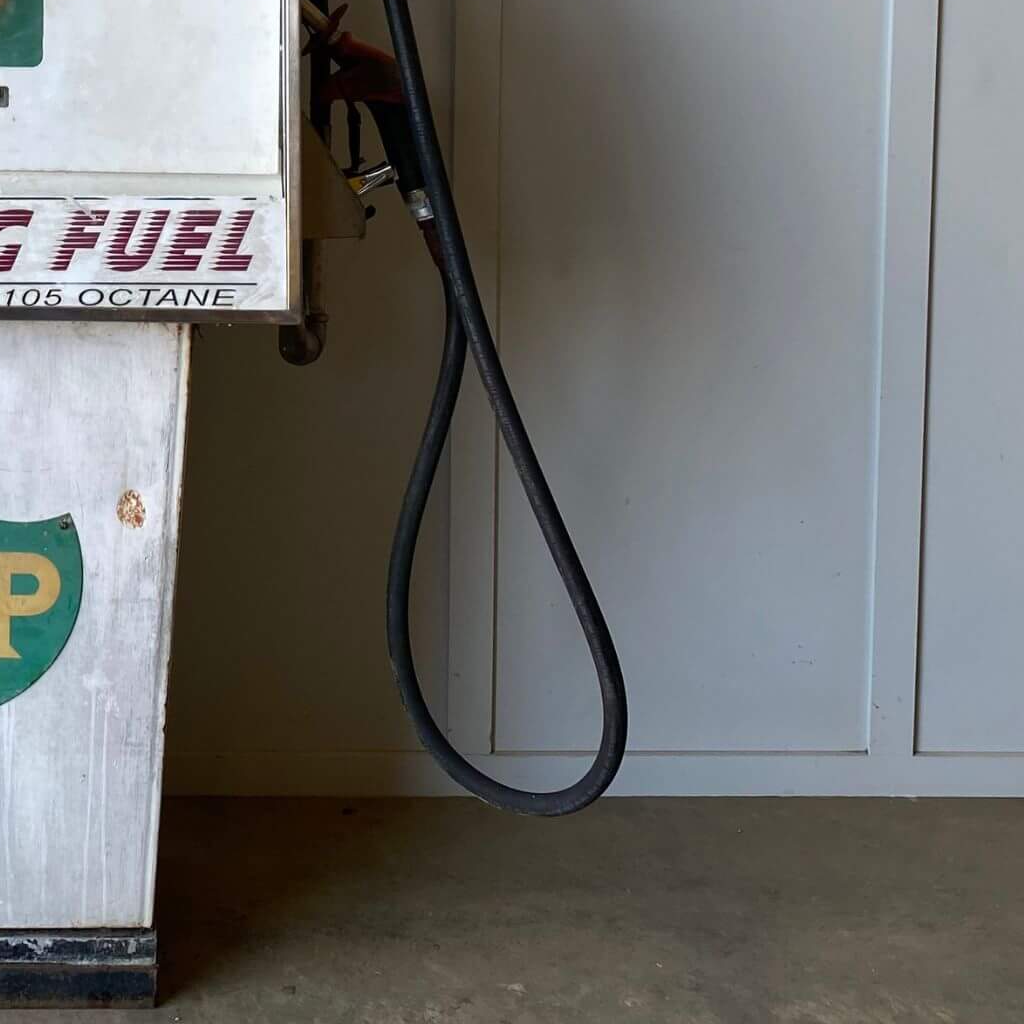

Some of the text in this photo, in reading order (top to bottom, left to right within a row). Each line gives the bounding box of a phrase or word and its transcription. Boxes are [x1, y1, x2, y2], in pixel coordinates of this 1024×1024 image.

[46, 209, 255, 272] FUEL
[5, 288, 62, 307] 105
[78, 288, 237, 307] OCTANE
